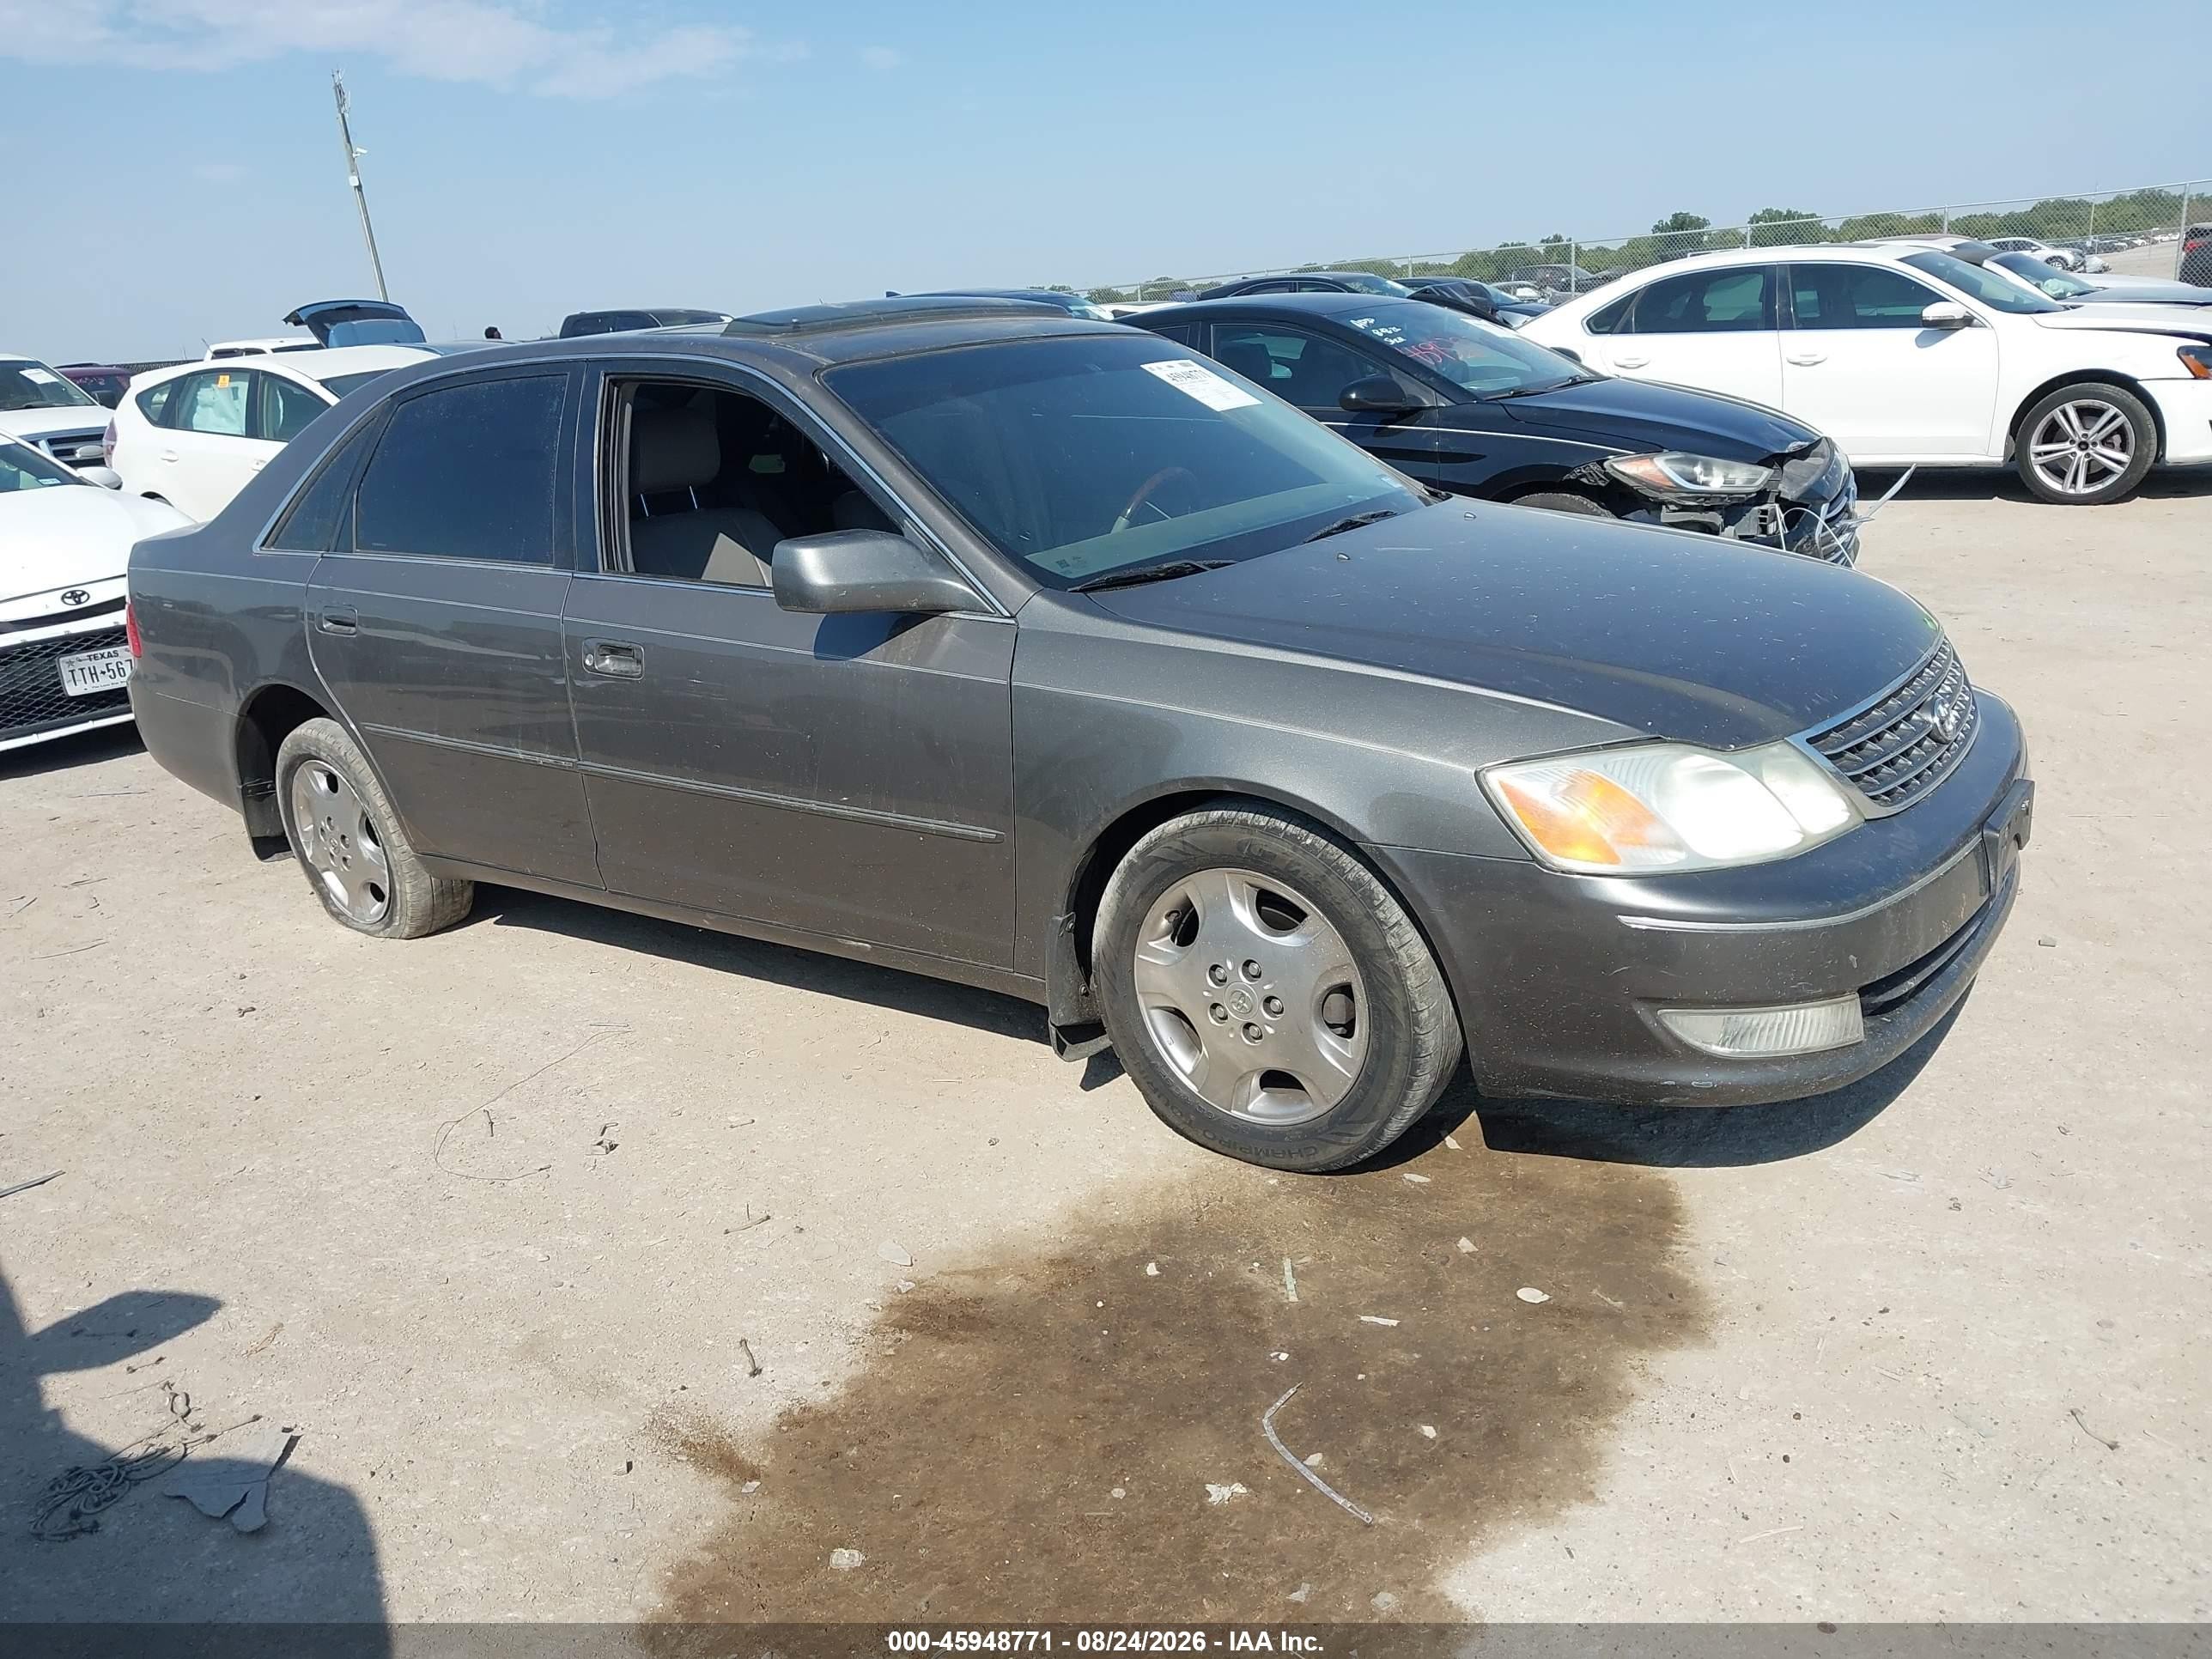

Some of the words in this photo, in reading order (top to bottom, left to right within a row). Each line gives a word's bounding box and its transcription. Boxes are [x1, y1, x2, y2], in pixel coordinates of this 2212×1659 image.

[87, 650, 119, 661] TEXAS
[69, 665, 100, 687] TTH
[1201, 1126, 1320, 1160] CHAMPIRO
